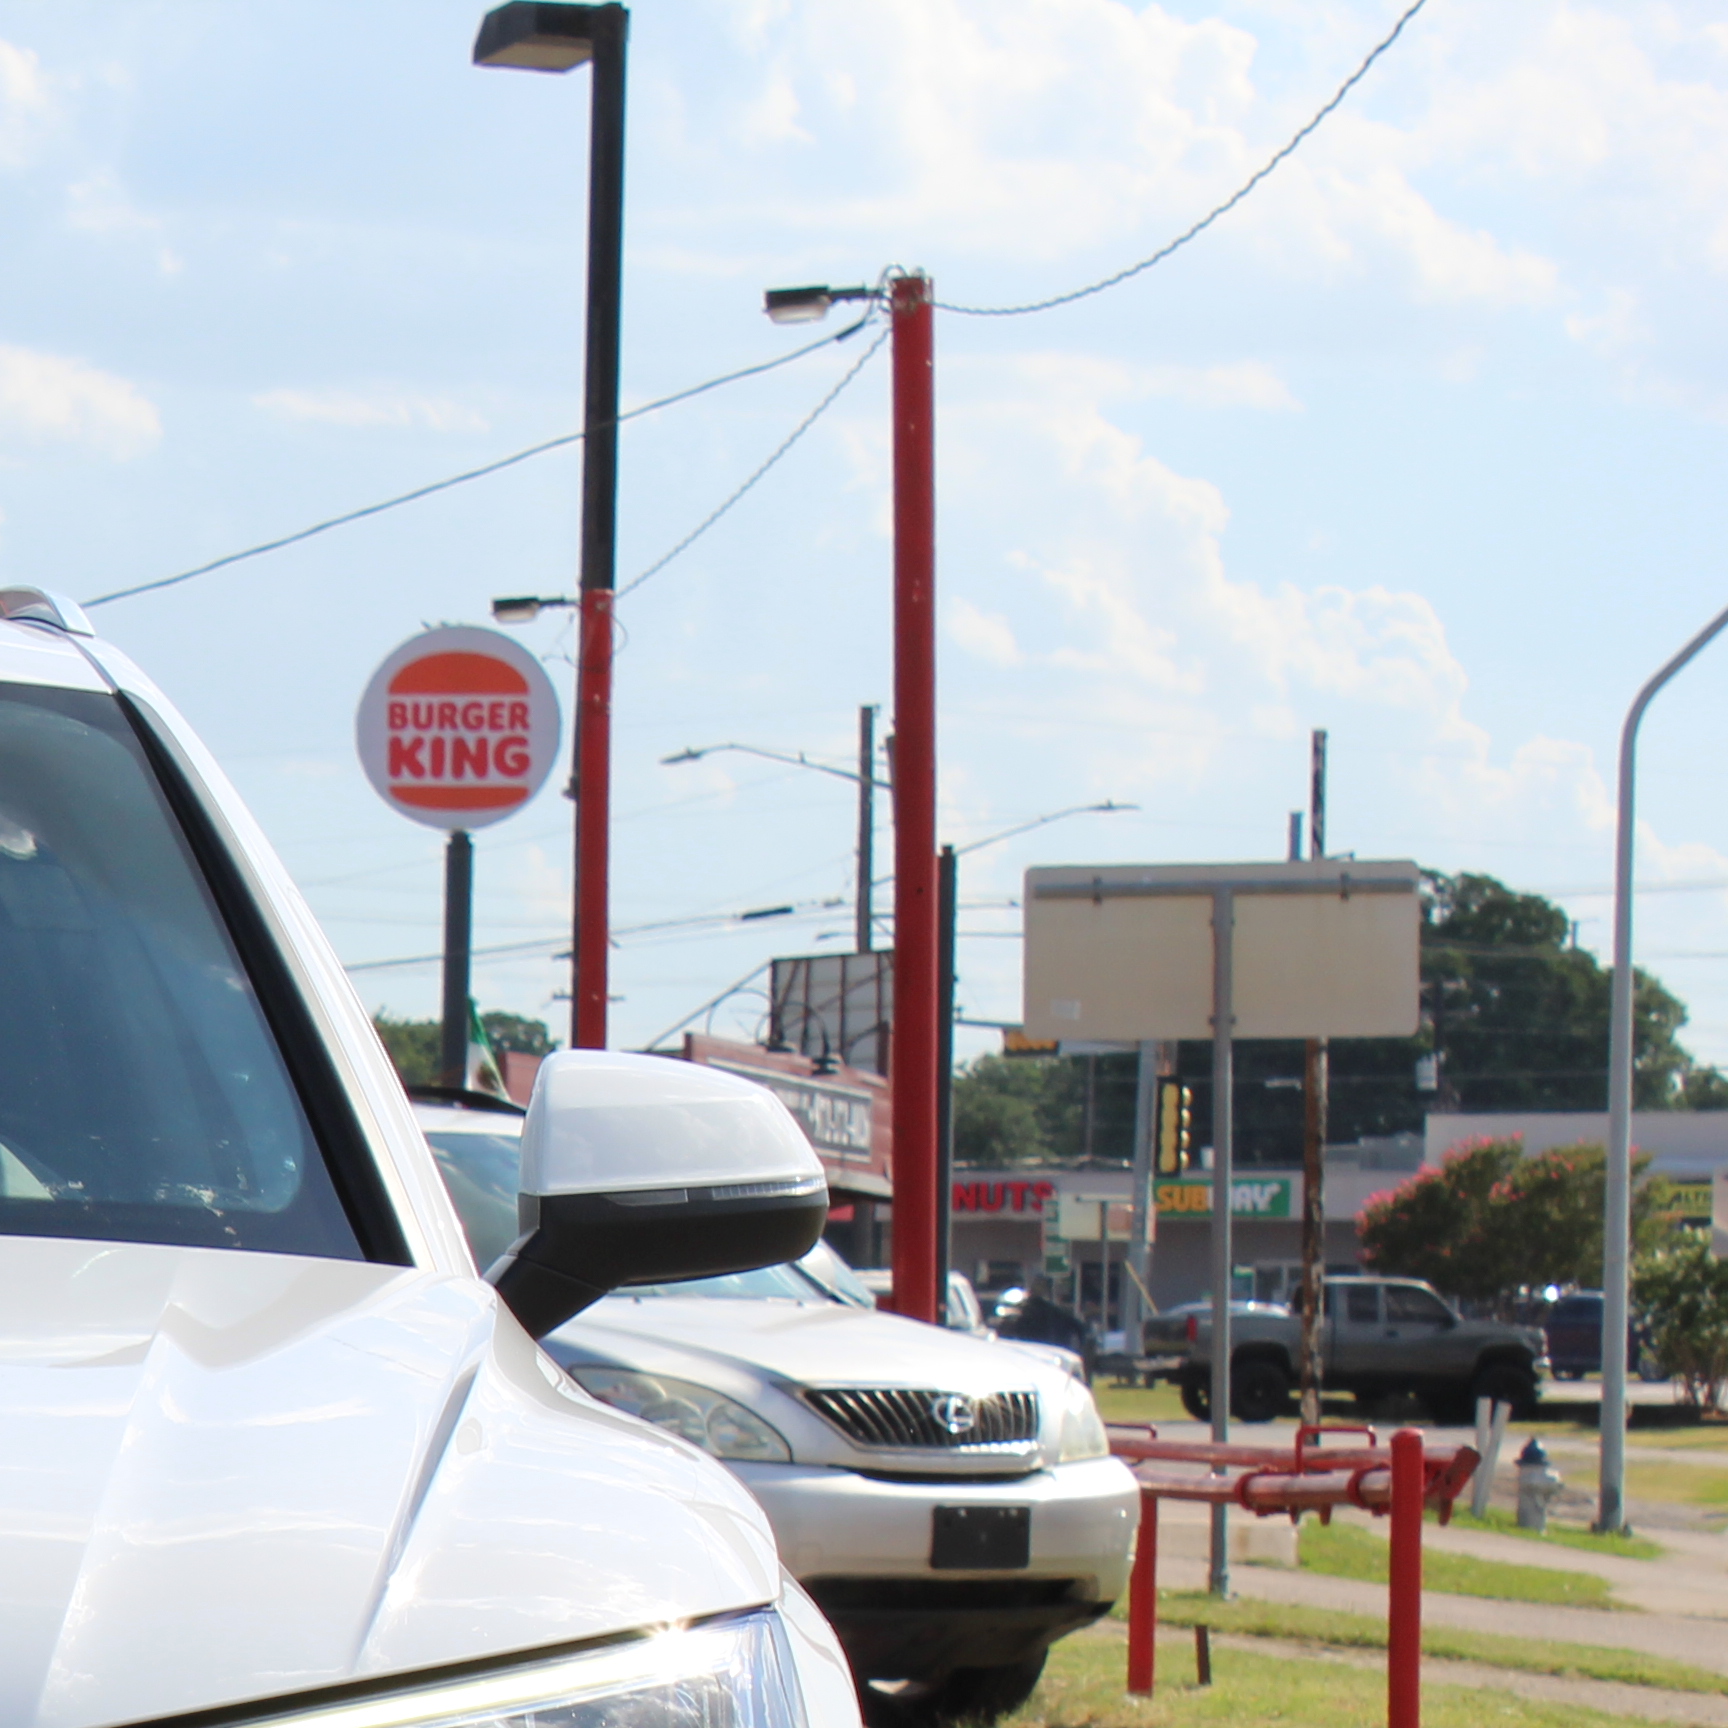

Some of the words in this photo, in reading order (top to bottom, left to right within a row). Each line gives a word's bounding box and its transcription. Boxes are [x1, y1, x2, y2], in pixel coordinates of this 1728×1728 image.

[388, 701, 530, 732] BURGER
[388, 735, 531, 779] KING
[1154, 1183, 1281, 1212] SUBAY
